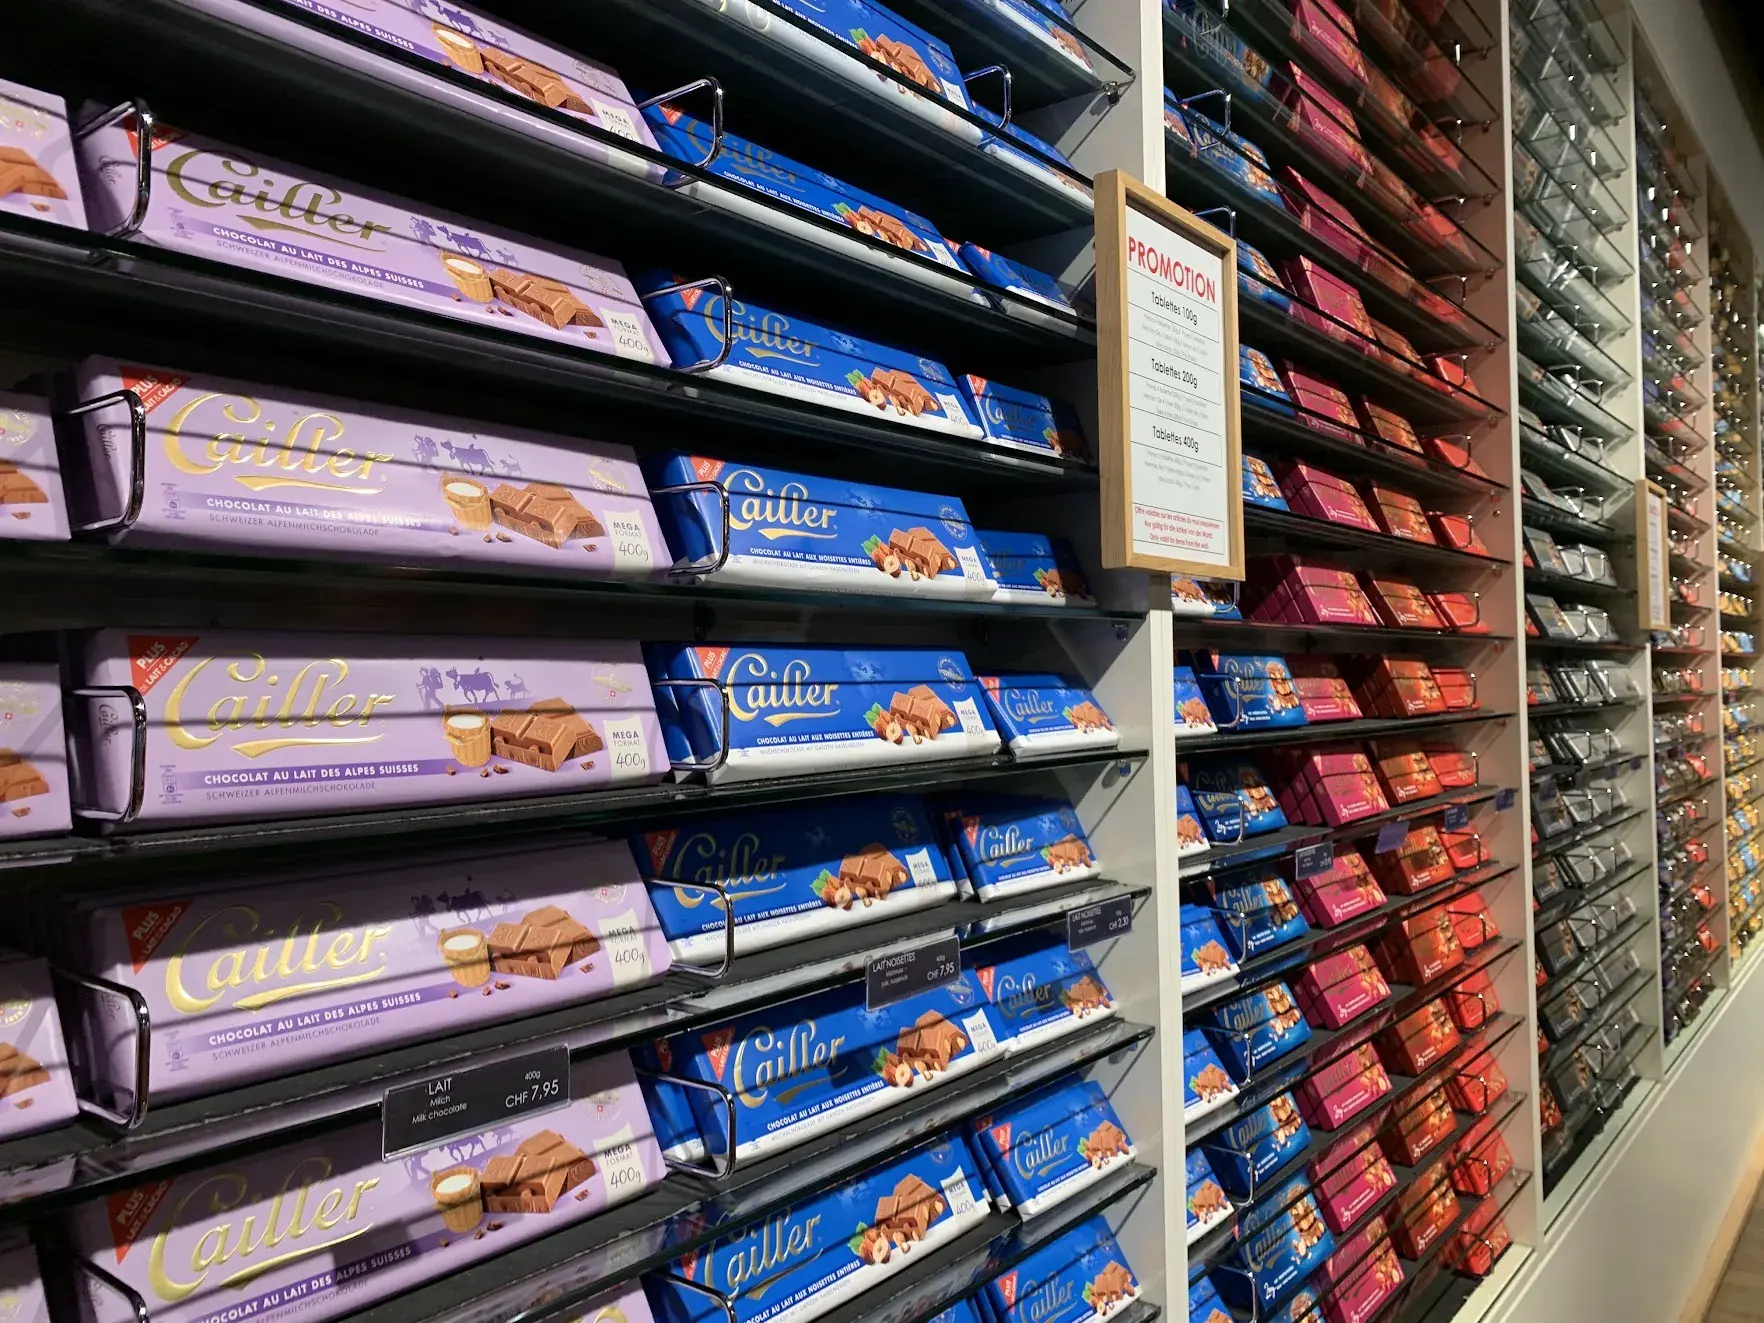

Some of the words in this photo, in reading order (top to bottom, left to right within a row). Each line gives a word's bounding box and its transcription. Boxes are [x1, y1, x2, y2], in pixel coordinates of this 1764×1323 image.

[317, 5, 337, 18] DES
[341, 11, 372, 32] ALPES
[375, 27, 414, 50] SUISSES
[166, 150, 392, 240] Cailler
[213, 226, 277, 250] CHOCOLAT
[281, 244, 297, 256] AU
[301, 249, 324, 263] LAIT
[327, 257, 348, 270] DES
[351, 262, 382, 278] ALPES
[384, 271, 424, 289] SUISSES
[216, 239, 271, 260] SCHWEIZER
[1128, 235, 1216, 304] PROMOTION
[1151, 291, 1181, 316] Tablettes
[1182, 306, 1198, 326] 100g
[610, 317, 637, 331] MEGA
[618, 335, 650, 357] 400g
[131, 374, 160, 397] PLUS
[738, 360, 770, 374] CHOCOLAT
[770, 368, 780, 376] AU
[779, 369, 793, 380] LAIT
[793, 374, 806, 384] AUX
[806, 377, 834, 391] NOISETTES
[1151, 358, 1181, 380] Tablettes
[1182, 370, 1198, 389] 200g
[164, 392, 395, 481] Cailler
[1152, 425, 1182, 446] Tablettes
[1183, 435, 1199, 453] 400g
[697, 459, 711, 478] PLUS
[206, 498, 271, 513] CHOCOLAT
[276, 505, 292, 516] AU
[295, 507, 319, 518] LAIT
[322, 509, 344, 521] DES
[381, 515, 423, 528] SUISSES
[720, 469, 838, 531] Cailler
[209, 513, 264, 526] SCHWEIZER
[613, 521, 640, 532] MEGA
[618, 541, 649, 562] 400g
[750, 547, 781, 558] CHOCOLAT
[783, 550, 791, 558] AU
[792, 551, 804, 561] LAIT
[805, 553, 817, 562] AUX
[818, 554, 848, 564] NOISETTES
[135, 640, 167, 670] PLUS
[703, 650, 716, 669] PLUS
[164, 650, 396, 750] Cailler
[725, 653, 839, 722] Cailler
[1004, 688, 1054, 722] Cailler
[612, 730, 640, 740] MEGA
[613, 739, 640, 748] FORMAT
[756, 736, 787, 746] CHOCOLAT
[788, 734, 797, 743] AU
[798, 733, 810, 742] LAIT
[811, 732, 823, 741] AUX
[823, 731, 851, 741] NOISETTES
[851, 729, 874, 739] ENTIÈRES
[204, 771, 268, 786] CHOCOLAT
[273, 770, 289, 781] AU
[293, 768, 317, 780] LAIT
[320, 767, 341, 778] DES
[344, 765, 376, 777] ALPES
[379, 763, 419, 775] SUISSES
[615, 752, 646, 771] 400g
[206, 788, 260, 801] SCHWEIZER
[264, 780, 376, 797] ALPENMILCHSCHOKOLADE
[980, 825, 1035, 867] Cailler
[673, 833, 787, 909] Cailler
[132, 909, 160, 941] PLUS
[743, 914, 756, 925] LAIT
[757, 910, 770, 921] AUX
[770, 905, 798, 918] NOISETTES
[798, 899, 823, 912] ENTIÈRES
[608, 926, 635, 938] MEGA
[165, 903, 393, 1015] Cailler
[615, 948, 645, 965] 400g
[872, 958, 886, 973] LAIT
[886, 951, 916, 969] NOISETTES
[927, 968, 939, 981] CHF
[939, 961, 955, 977] 7,95
[997, 972, 1051, 1019] Cailler
[208, 1023, 273, 1046] CHOCOLAT
[277, 1018, 293, 1032] AU
[297, 1013, 321, 1027] LAIT
[324, 1008, 345, 1022] DES
[348, 1001, 379, 1017] ALPES
[381, 991, 421, 1010] SUISSES
[212, 1042, 267, 1062] SCHWEIZER
[733, 1019, 846, 1109] Cailler
[427, 1077, 453, 1096] LAIT
[524, 1070, 542, 1081] 400g
[429, 1095, 451, 1107] Milch
[505, 1091, 529, 1109] CHF
[530, 1078, 560, 1102] 7,95
[766, 1112, 798, 1132] CHOCOLAT
[799, 1108, 808, 1119] AU
[808, 1101, 821, 1116] LAIT
[821, 1097, 834, 1111] AUX
[833, 1087, 862, 1107] NOISETTES
[861, 1078, 885, 1098] ENTIÈRES
[411, 1110, 427, 1125] Milk
[428, 1101, 468, 1121] chocolate
[604, 1143, 632, 1159] MEGA
[1014, 1125, 1069, 1180] Cailler
[610, 1166, 641, 1189] 400g
[115, 1189, 145, 1225] PLUS
[149, 1156, 381, 1302] Cailler
[262, 1293, 280, 1309] AU
[283, 1283, 308, 1301] LAIT
[311, 1274, 332, 1290] DES
[335, 1261, 368, 1283] ALPES
[371, 1245, 412, 1269] SUISSES
[771, 1302, 781, 1315] AU
[780, 1296, 794, 1311] LAIT
[794, 1288, 808, 1302] AUX
[807, 1271, 837, 1293] NOISETTES
[836, 1259, 861, 1279] ENTIÈRES
